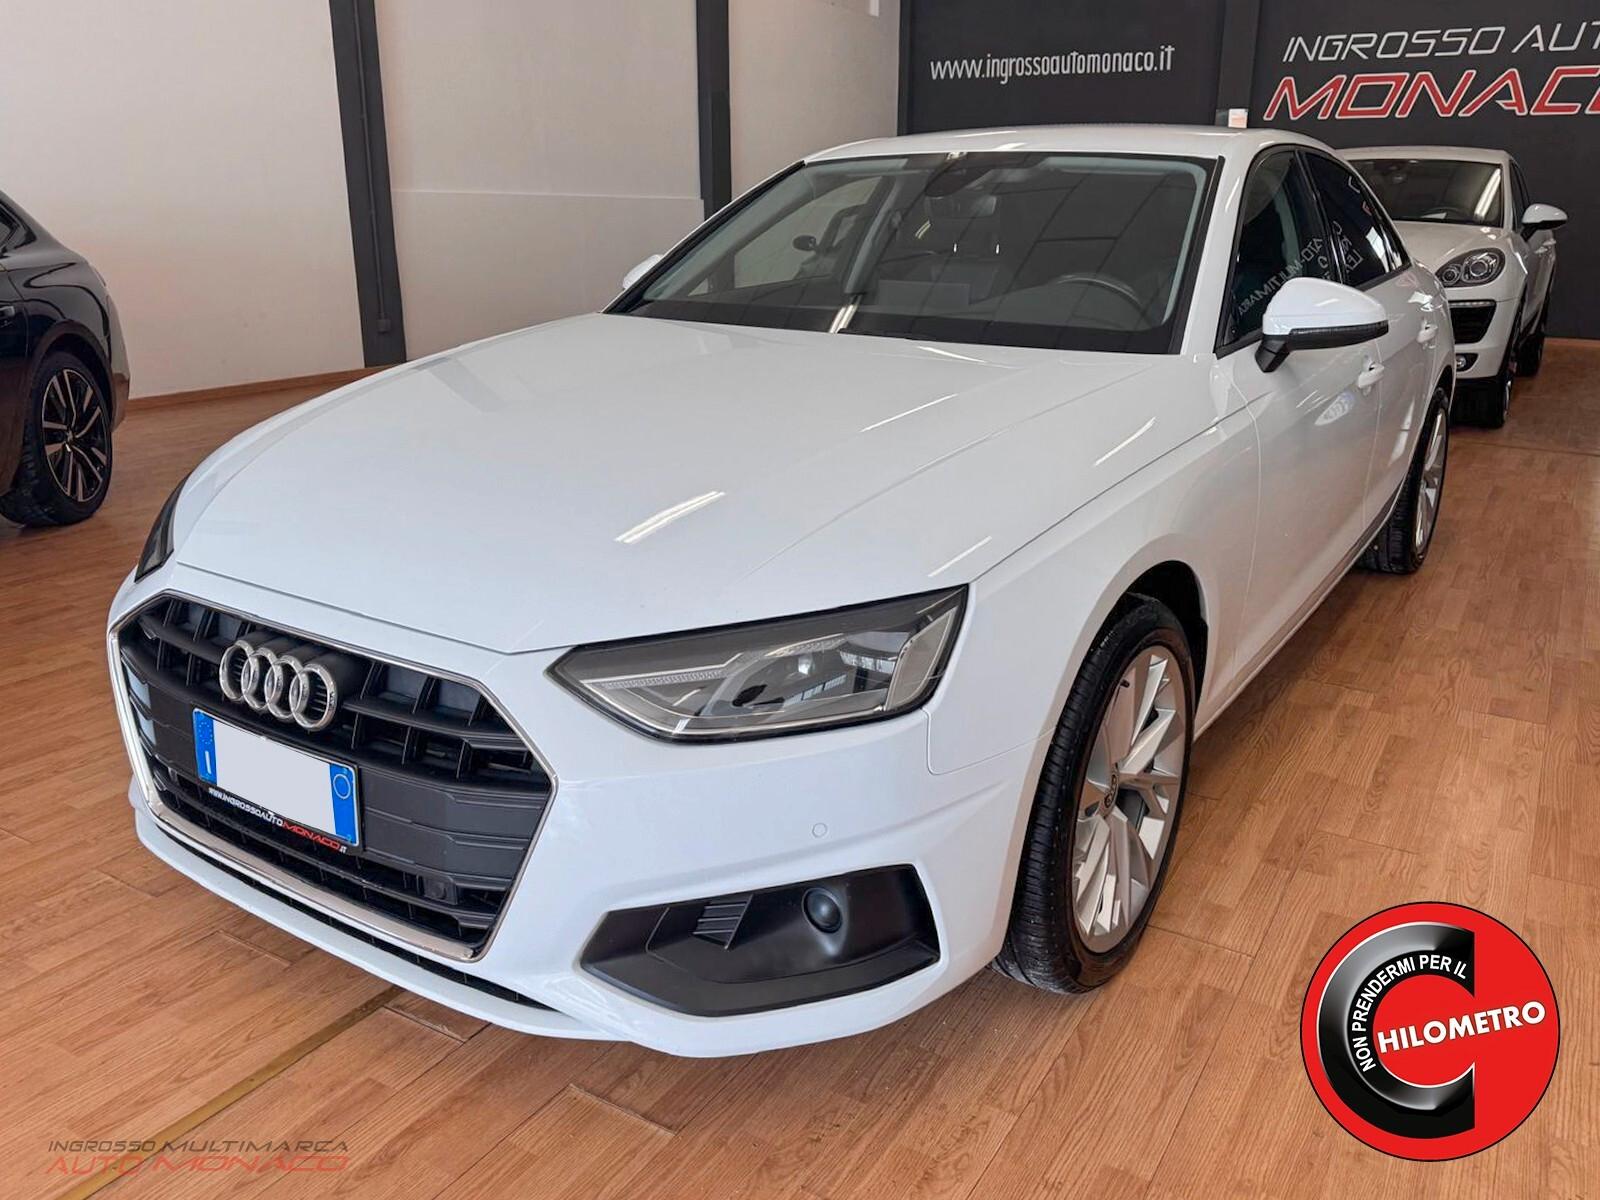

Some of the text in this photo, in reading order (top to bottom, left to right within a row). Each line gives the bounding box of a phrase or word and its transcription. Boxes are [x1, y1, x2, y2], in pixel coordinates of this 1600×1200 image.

[1283, 26, 1505, 62] INGROSSO
[930, 45, 1175, 85] www.ingrossoautomonaco.it
[1263, 65, 1600, 121] MONAC
